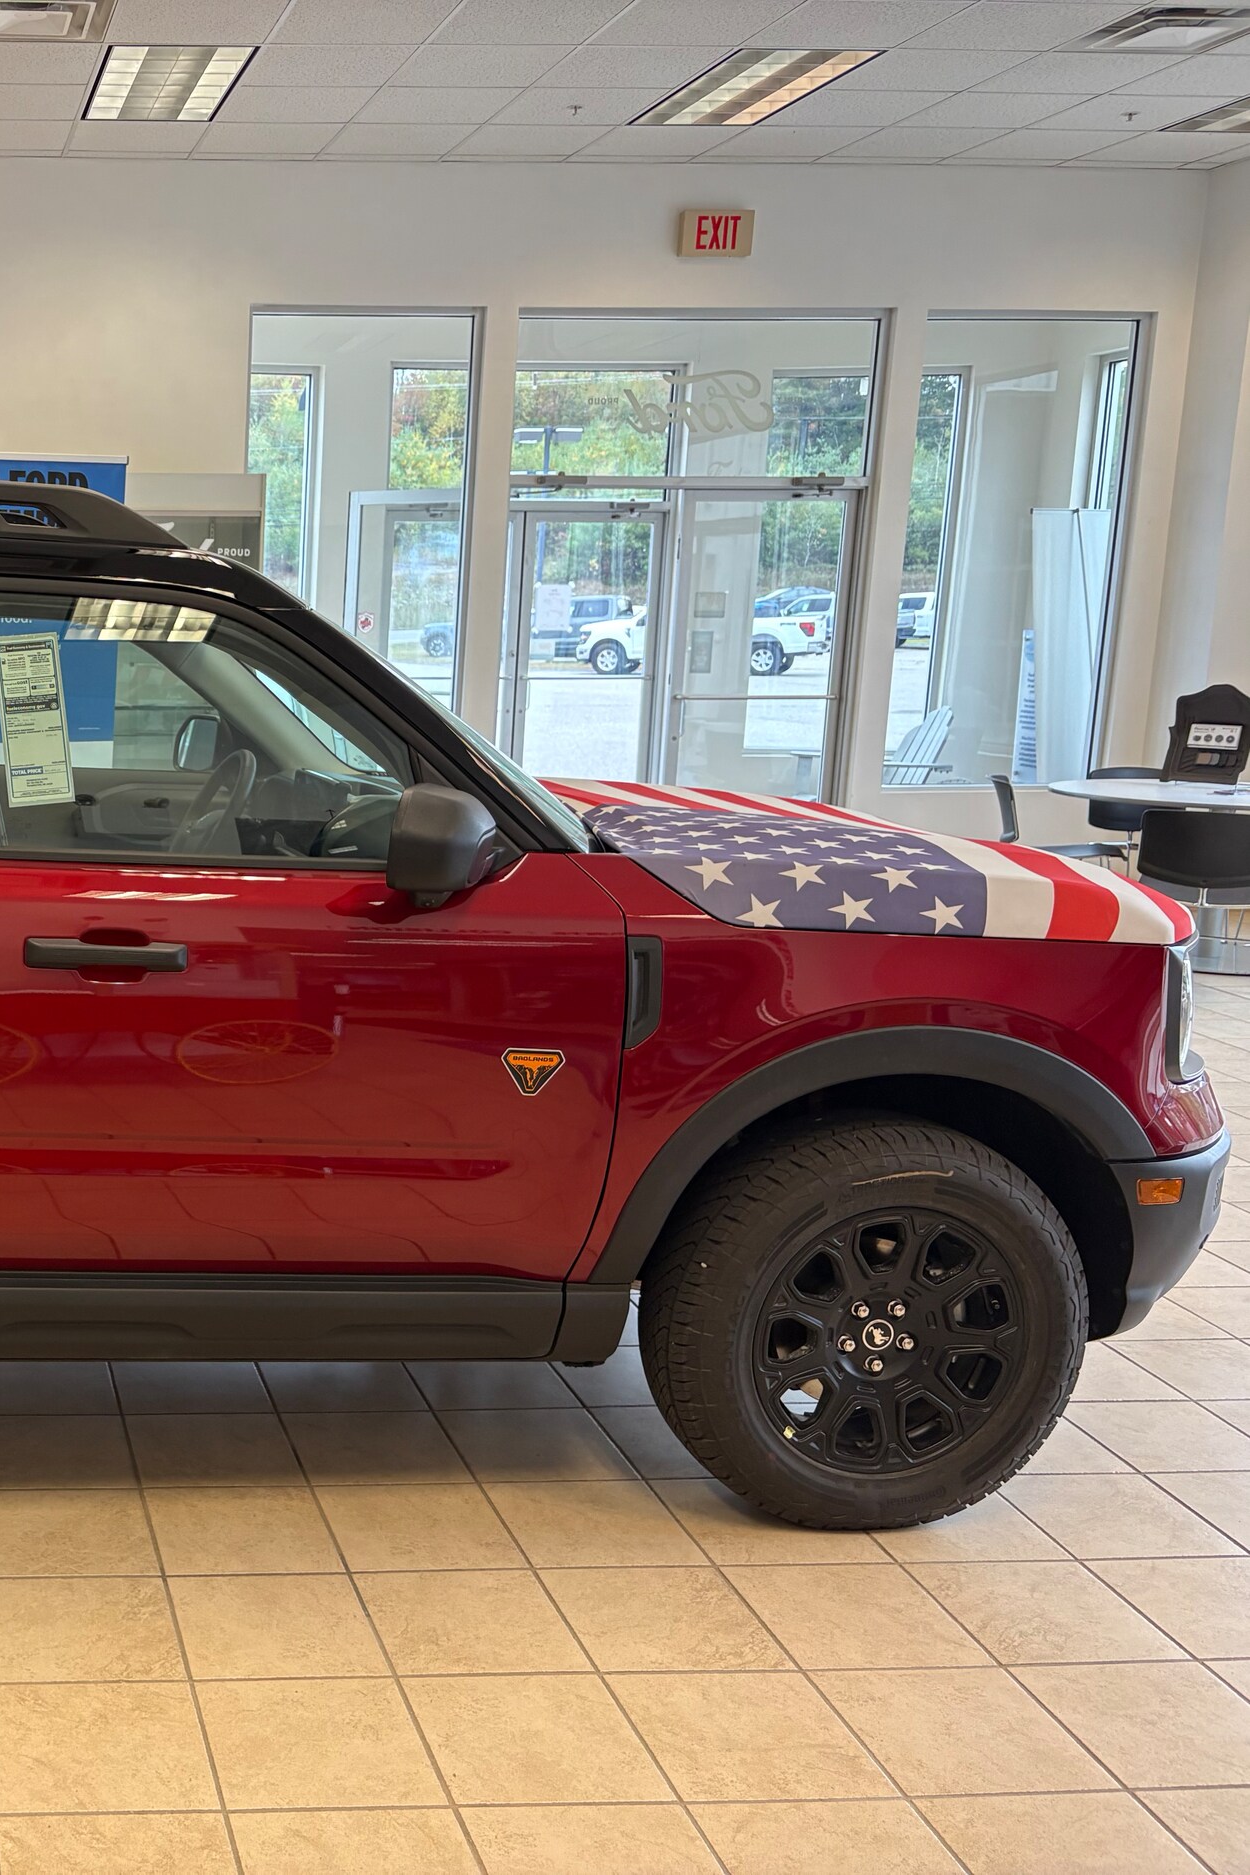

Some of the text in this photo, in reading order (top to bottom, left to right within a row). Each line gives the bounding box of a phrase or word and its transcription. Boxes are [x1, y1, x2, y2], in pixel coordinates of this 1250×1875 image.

[695, 215, 742, 250] EXIT
[217, 547, 251, 557] PROUD
[513, 1055, 554, 1063] BADLANDS
